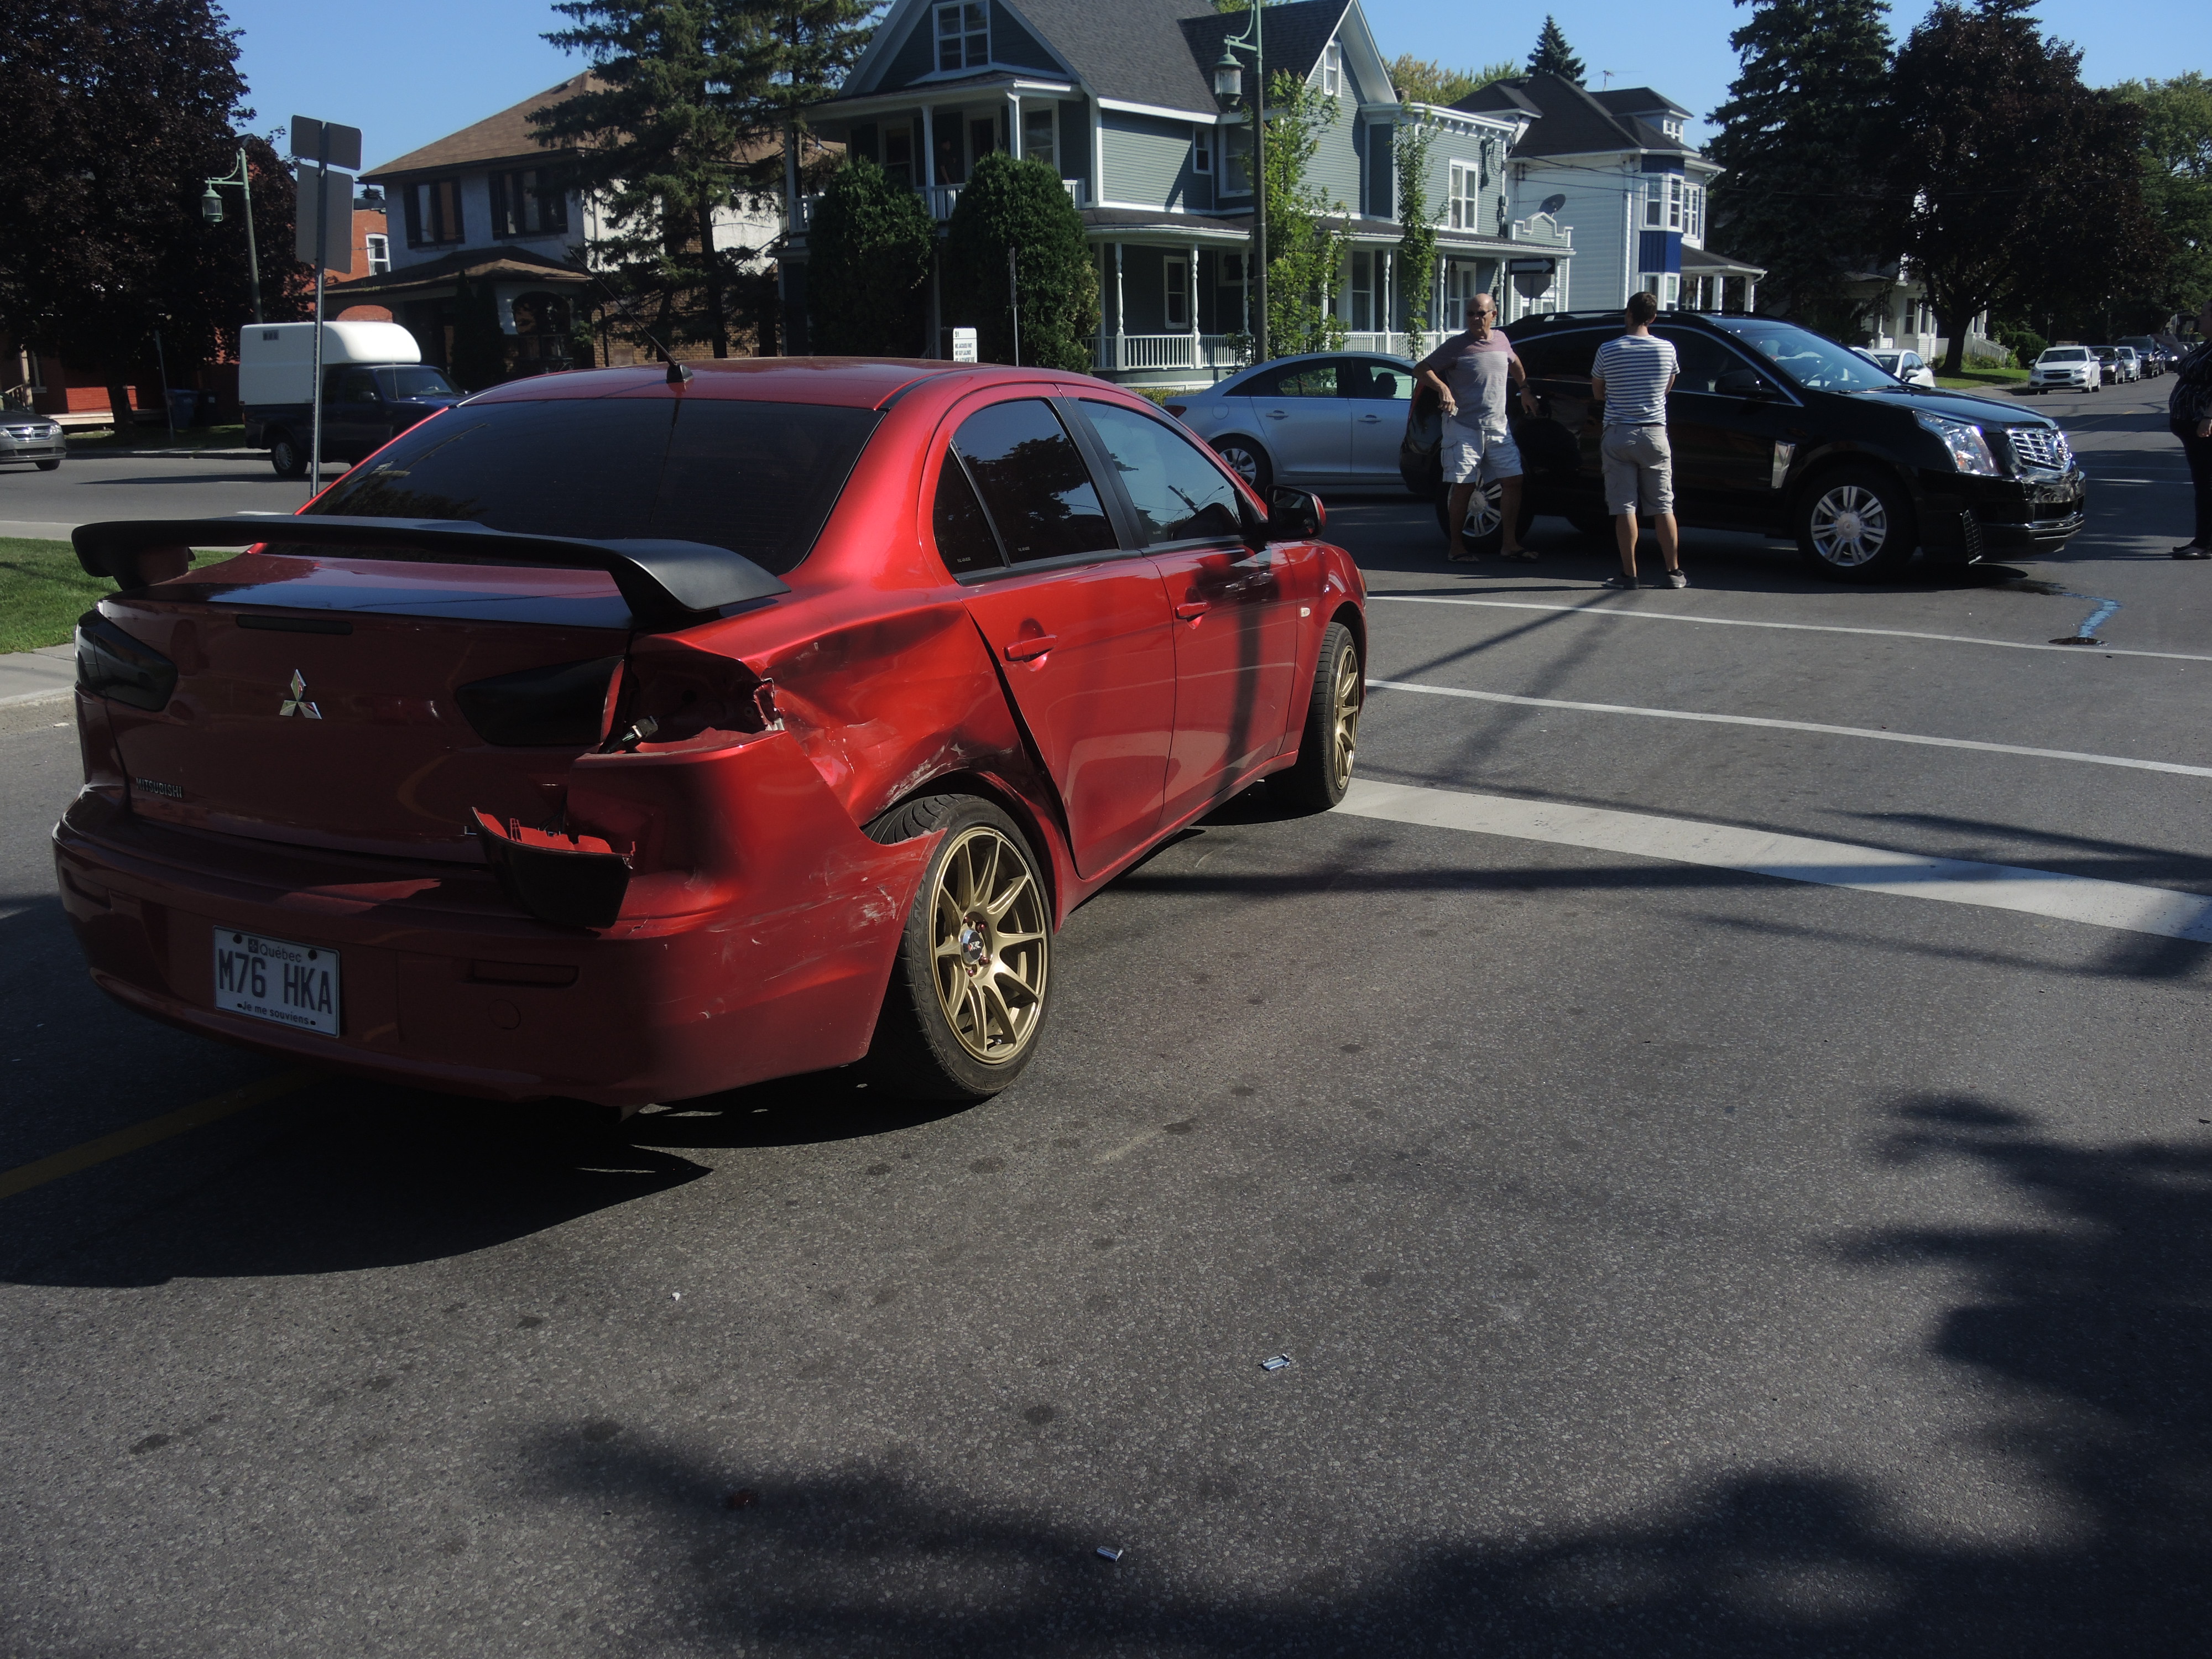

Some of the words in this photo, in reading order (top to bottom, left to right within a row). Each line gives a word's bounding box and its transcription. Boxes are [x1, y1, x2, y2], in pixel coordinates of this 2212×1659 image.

[136, 776, 183, 799] MITSUBISHI
[260, 943, 302, 963] Québec
[218, 948, 266, 998] M76
[284, 963, 332, 1015] HKA
[242, 1000, 252, 1011] Je
[254, 1005, 267, 1015] me
[269, 1009, 310, 1024] souviens
